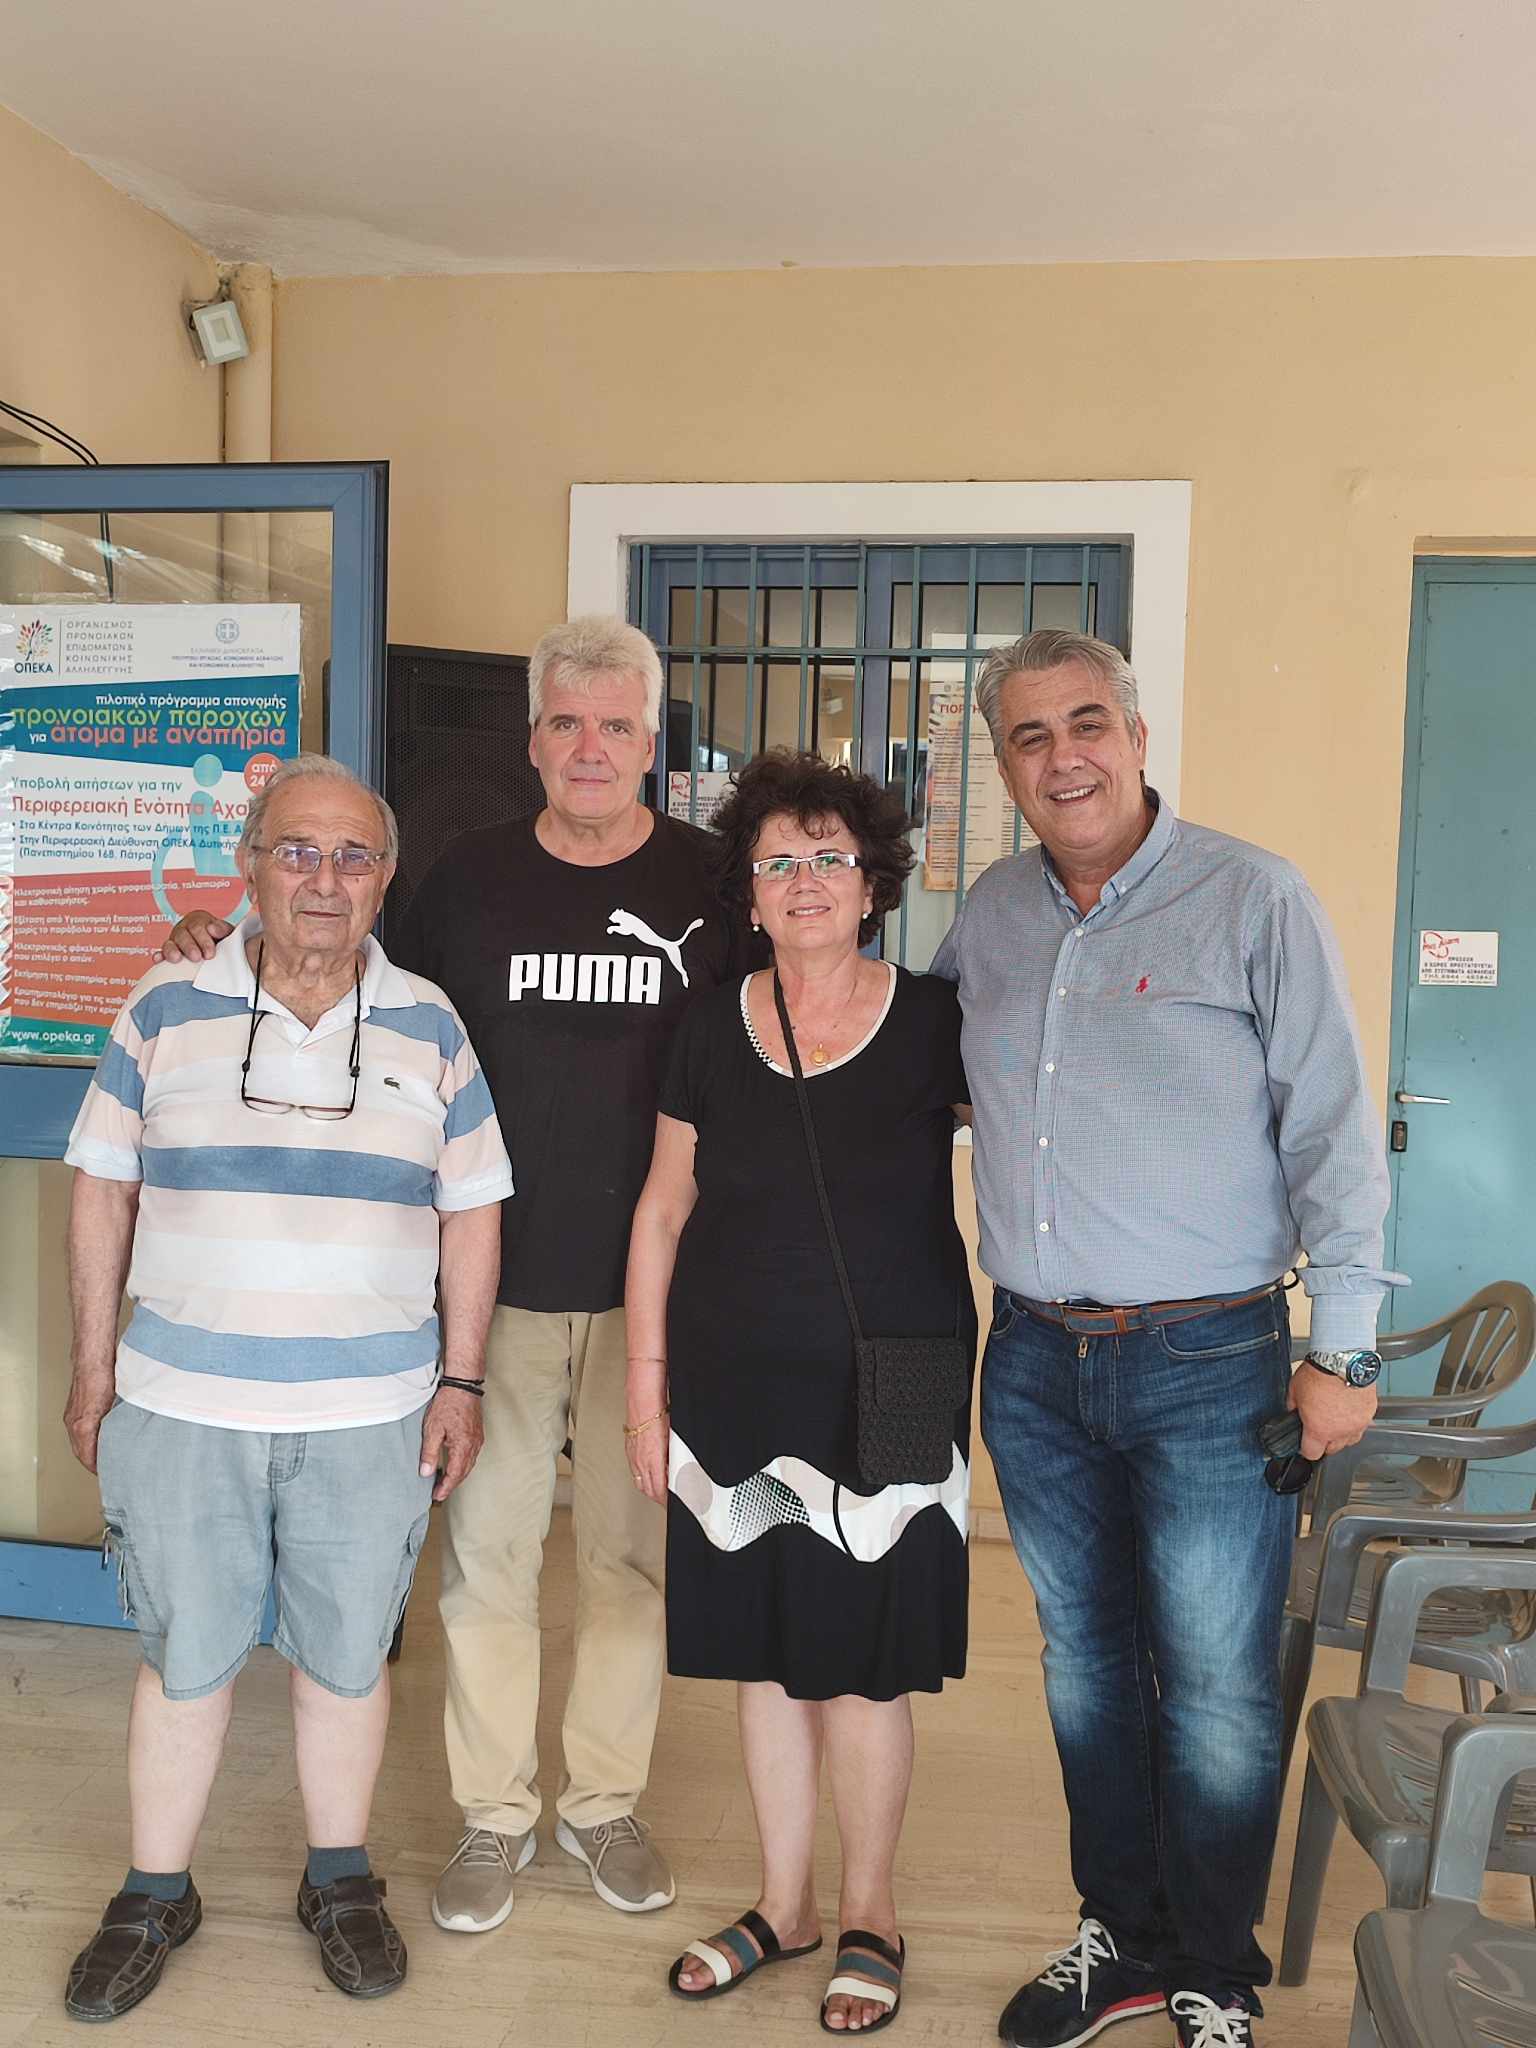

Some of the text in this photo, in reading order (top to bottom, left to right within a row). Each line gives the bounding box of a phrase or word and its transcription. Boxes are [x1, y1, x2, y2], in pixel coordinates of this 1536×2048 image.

[66, 620, 134, 629] ΟΡΓΑΝΙΣΜΟΣ
[66, 631, 134, 640] ΠΡΟΝΟΙΑΚΩΝ
[66, 654, 134, 663] ΚΟΙΝΩΝΙΚΗΣ
[14, 661, 54, 674] ΟΠΕΚΑ
[96, 693, 288, 709] πιλοτικό πρόγραμμα απονομής
[169, 705, 287, 731] παροχών
[29, 732, 47, 744] για
[50, 720, 125, 748] άτομα
[133, 727, 159, 748] με
[11, 776, 182, 793] Υποβολή αιτήσεων για την
[12, 795, 128, 815] Περιφερειακή
[134, 797, 204, 816] Ενότητα
[19, 819, 35, 830] Στα
[162, 837, 196, 848] ΟΠΕΚΑ
[509, 953, 662, 1005] PUMA
